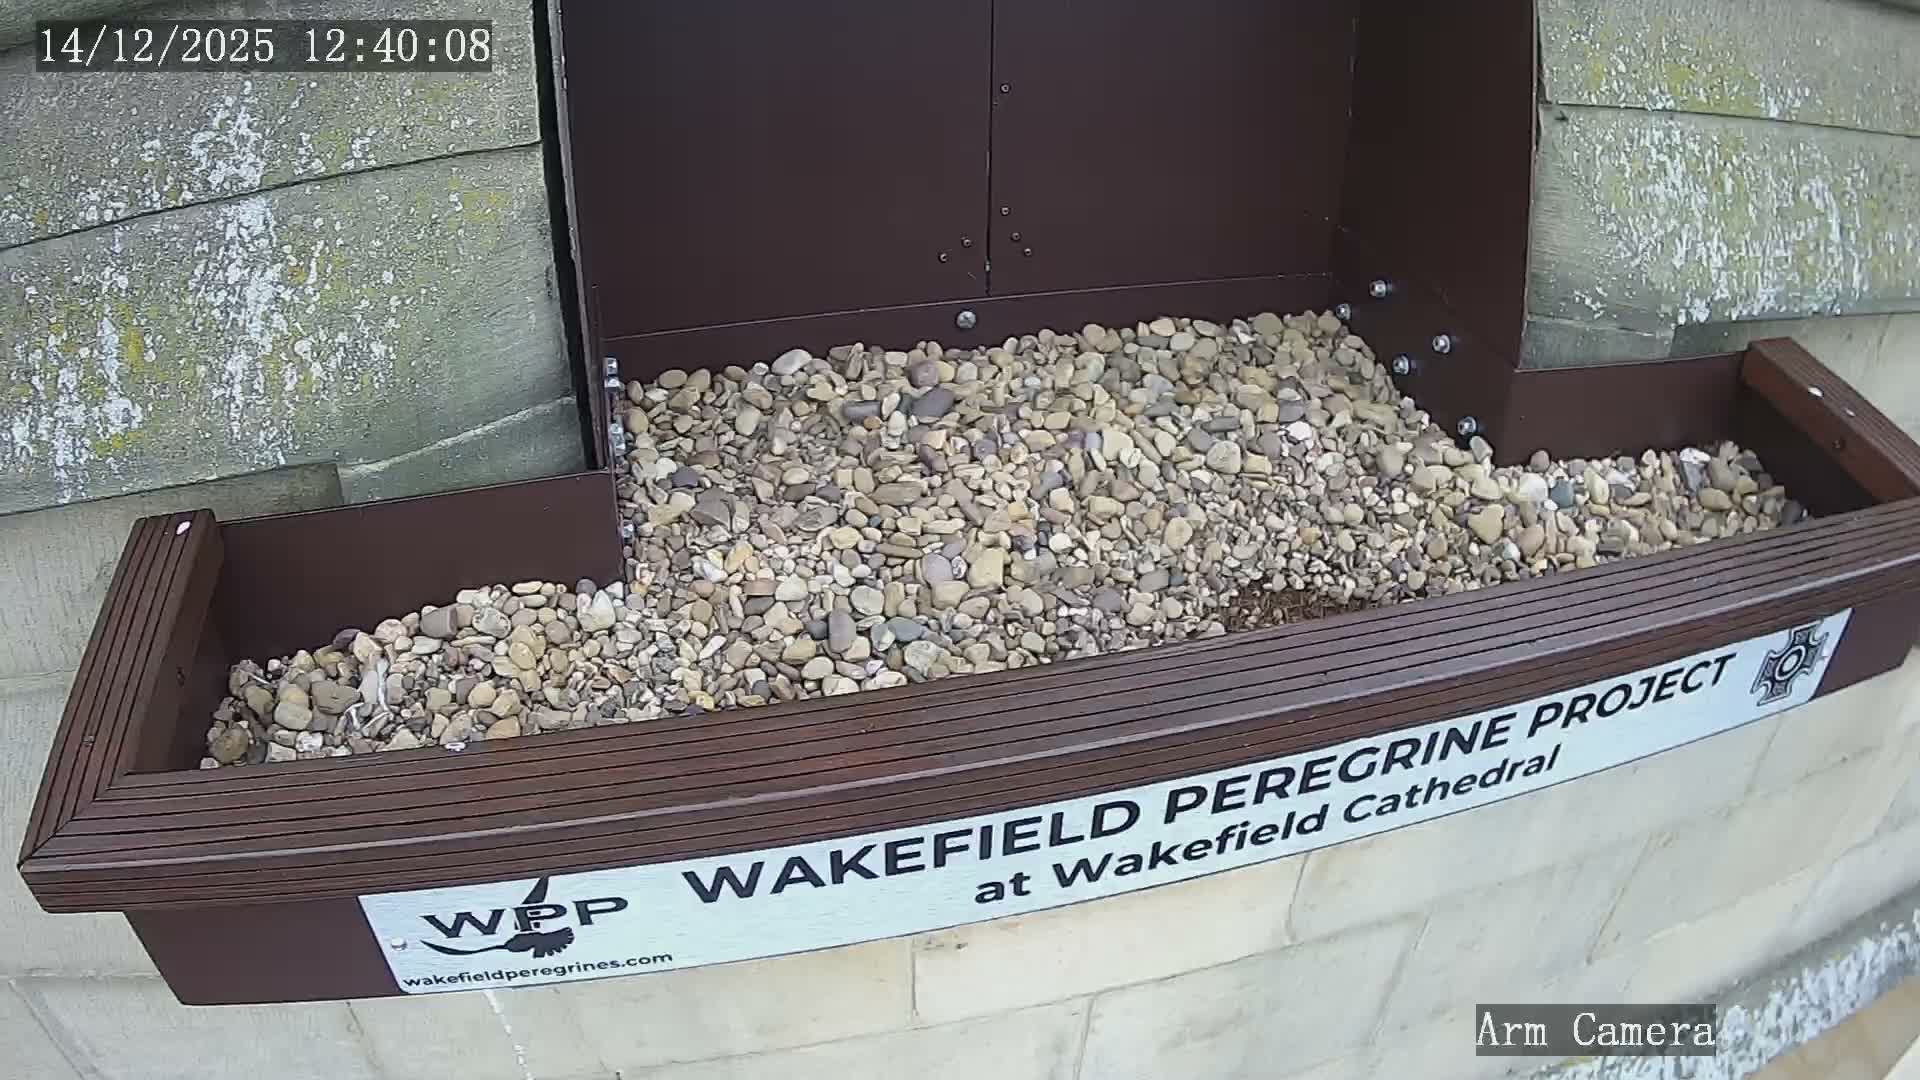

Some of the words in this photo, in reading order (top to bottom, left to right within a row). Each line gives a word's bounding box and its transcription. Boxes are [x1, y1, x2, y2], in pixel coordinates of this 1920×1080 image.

[682, 800, 1141, 904] WAKEFIELD
[1164, 712, 1518, 824] PEREGRINE
[1527, 653, 1737, 738] PROJECT
[974, 872, 1031, 904] at
[1052, 806, 1330, 889] Wakefield
[1342, 744, 1562, 824] Cathedral
[421, 896, 629, 939] WPP
[403, 952, 673, 988] wakefieldperegrines.com
